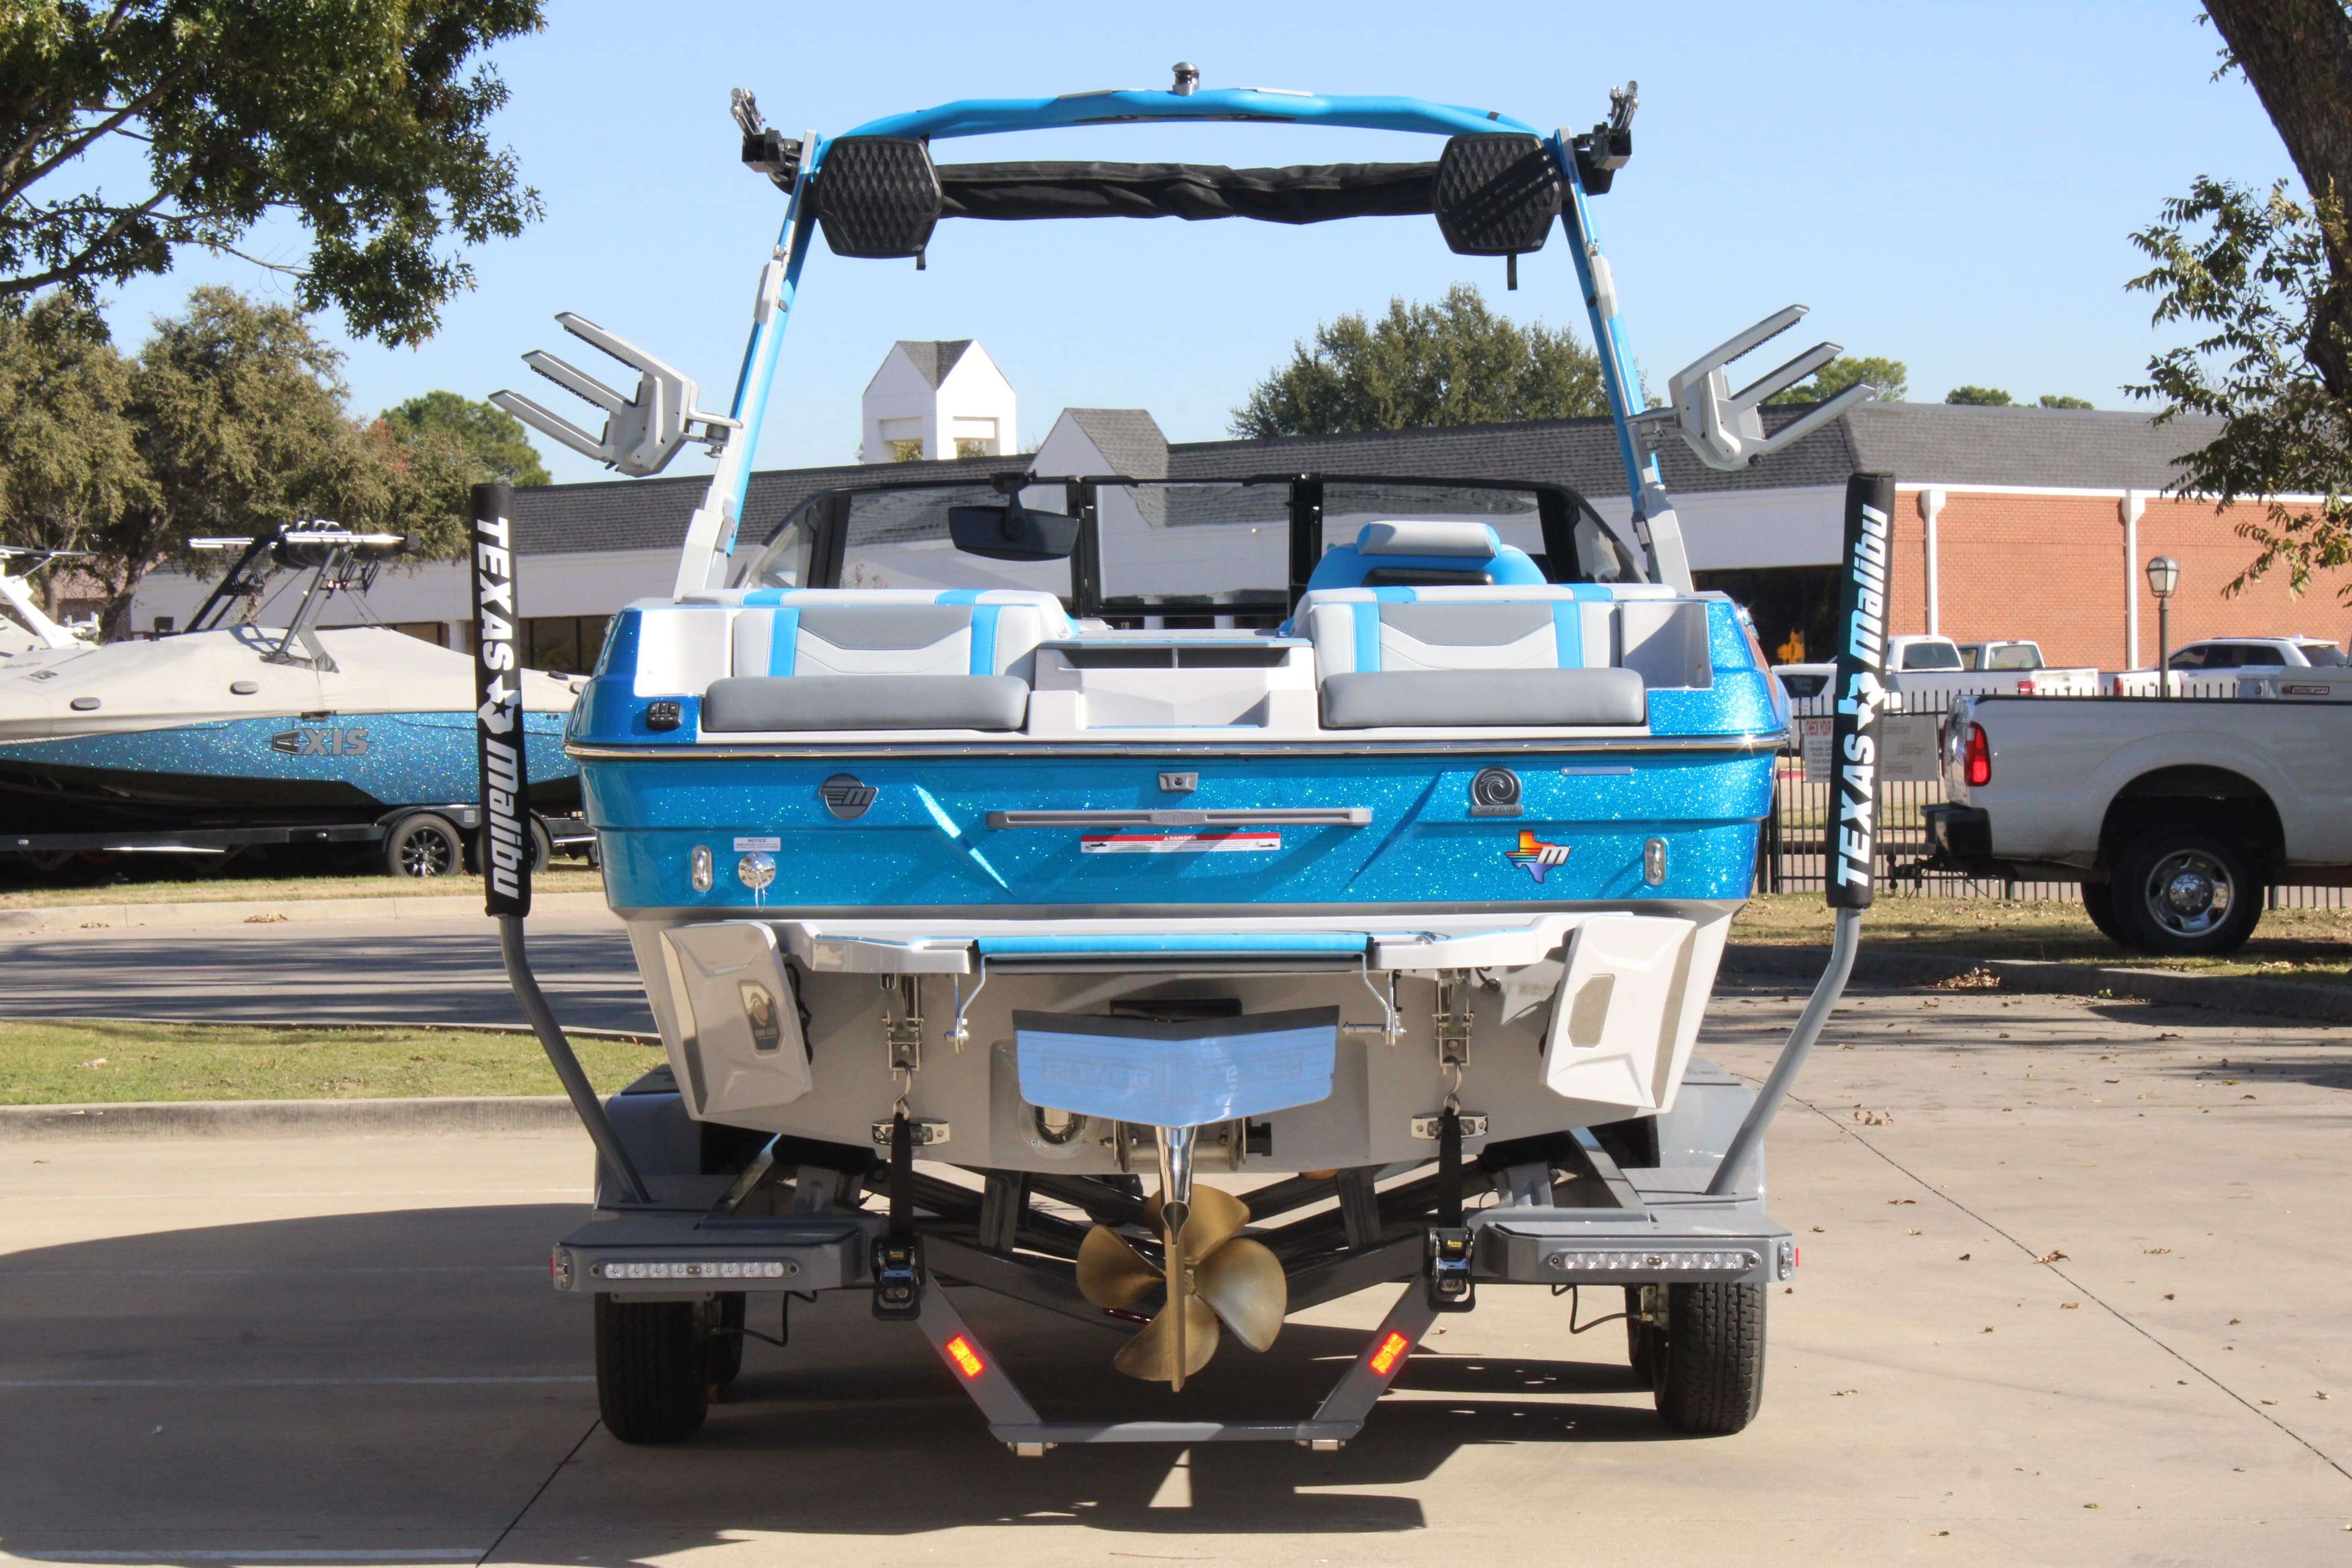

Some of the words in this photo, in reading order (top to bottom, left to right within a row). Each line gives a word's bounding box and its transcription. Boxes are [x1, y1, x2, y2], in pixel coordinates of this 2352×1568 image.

[477, 517, 514, 671] TEXAS
[272, 728, 368, 756] AXIS
[1837, 734, 1875, 888] TEXAS
